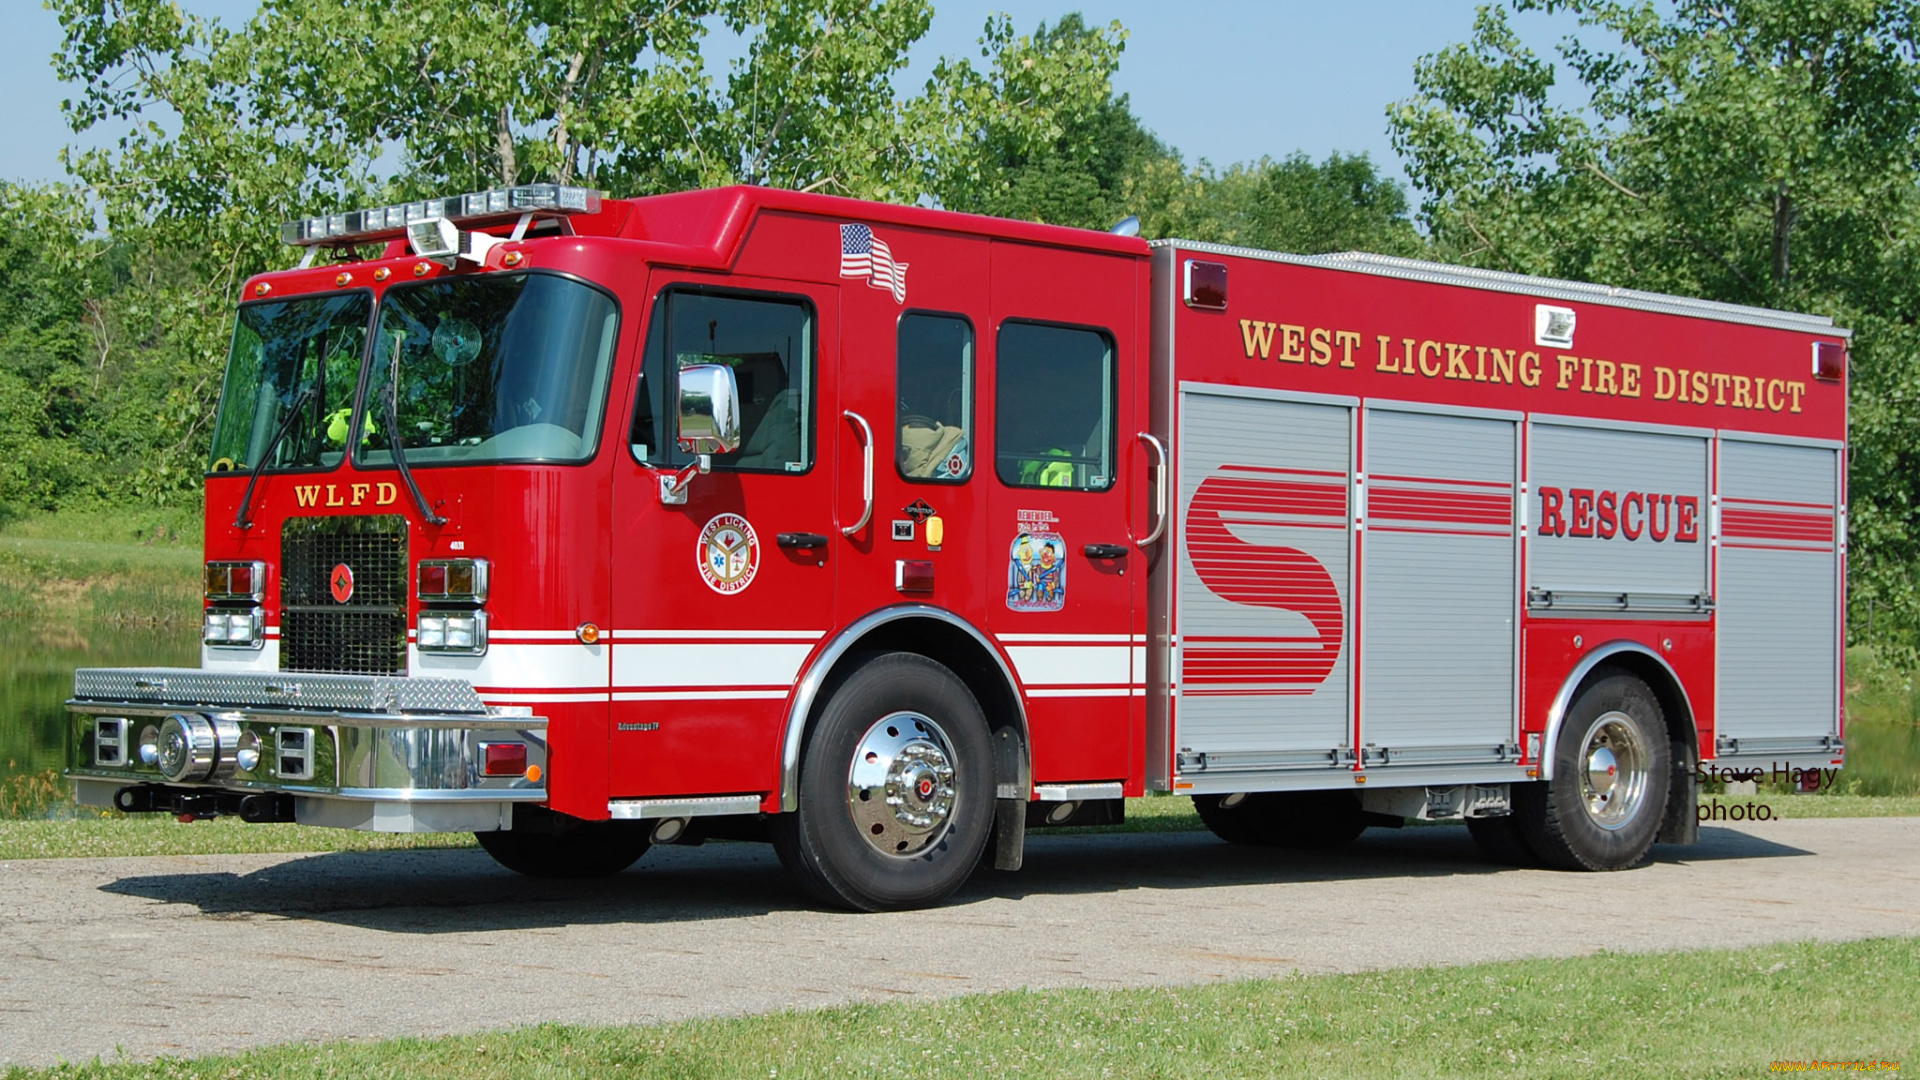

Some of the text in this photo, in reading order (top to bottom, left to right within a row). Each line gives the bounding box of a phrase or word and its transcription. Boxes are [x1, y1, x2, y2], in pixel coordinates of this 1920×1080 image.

[1239, 319, 1806, 414] WEST LICKING FIRE DISTRICT
[294, 482, 398, 508] WLFD
[905, 506, 934, 514] SPARTAN
[1538, 486, 1699, 543] RESCUE
[701, 516, 757, 547] WEST LICKING
[701, 562, 756, 592] FIRE DISTRICT
